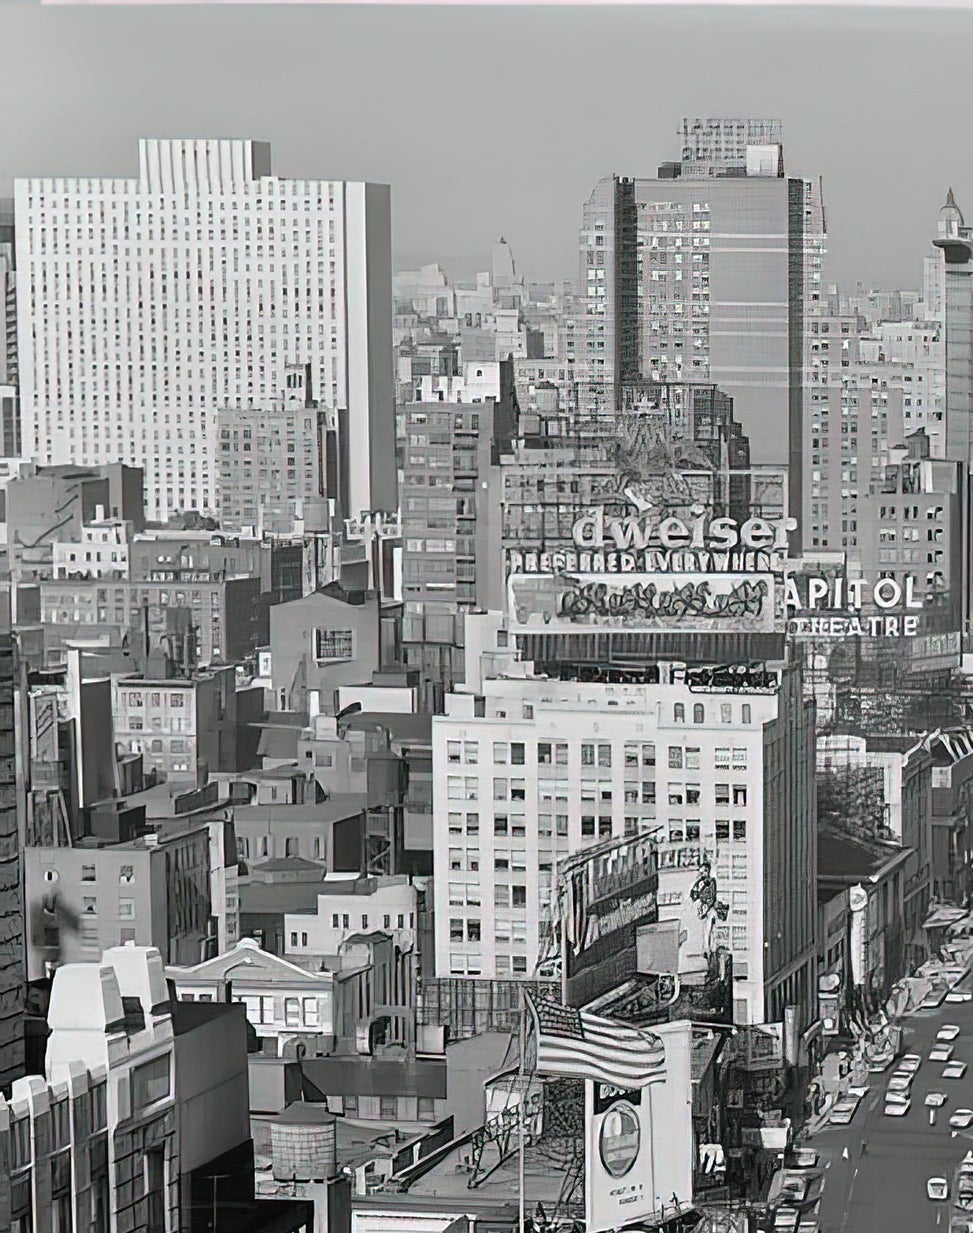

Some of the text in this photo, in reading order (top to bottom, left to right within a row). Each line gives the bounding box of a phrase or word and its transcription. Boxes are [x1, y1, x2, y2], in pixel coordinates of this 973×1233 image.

[572, 504, 797, 549] dweiser
[785, 577, 923, 609] APITOL
[793, 615, 920, 637] THEATRE
